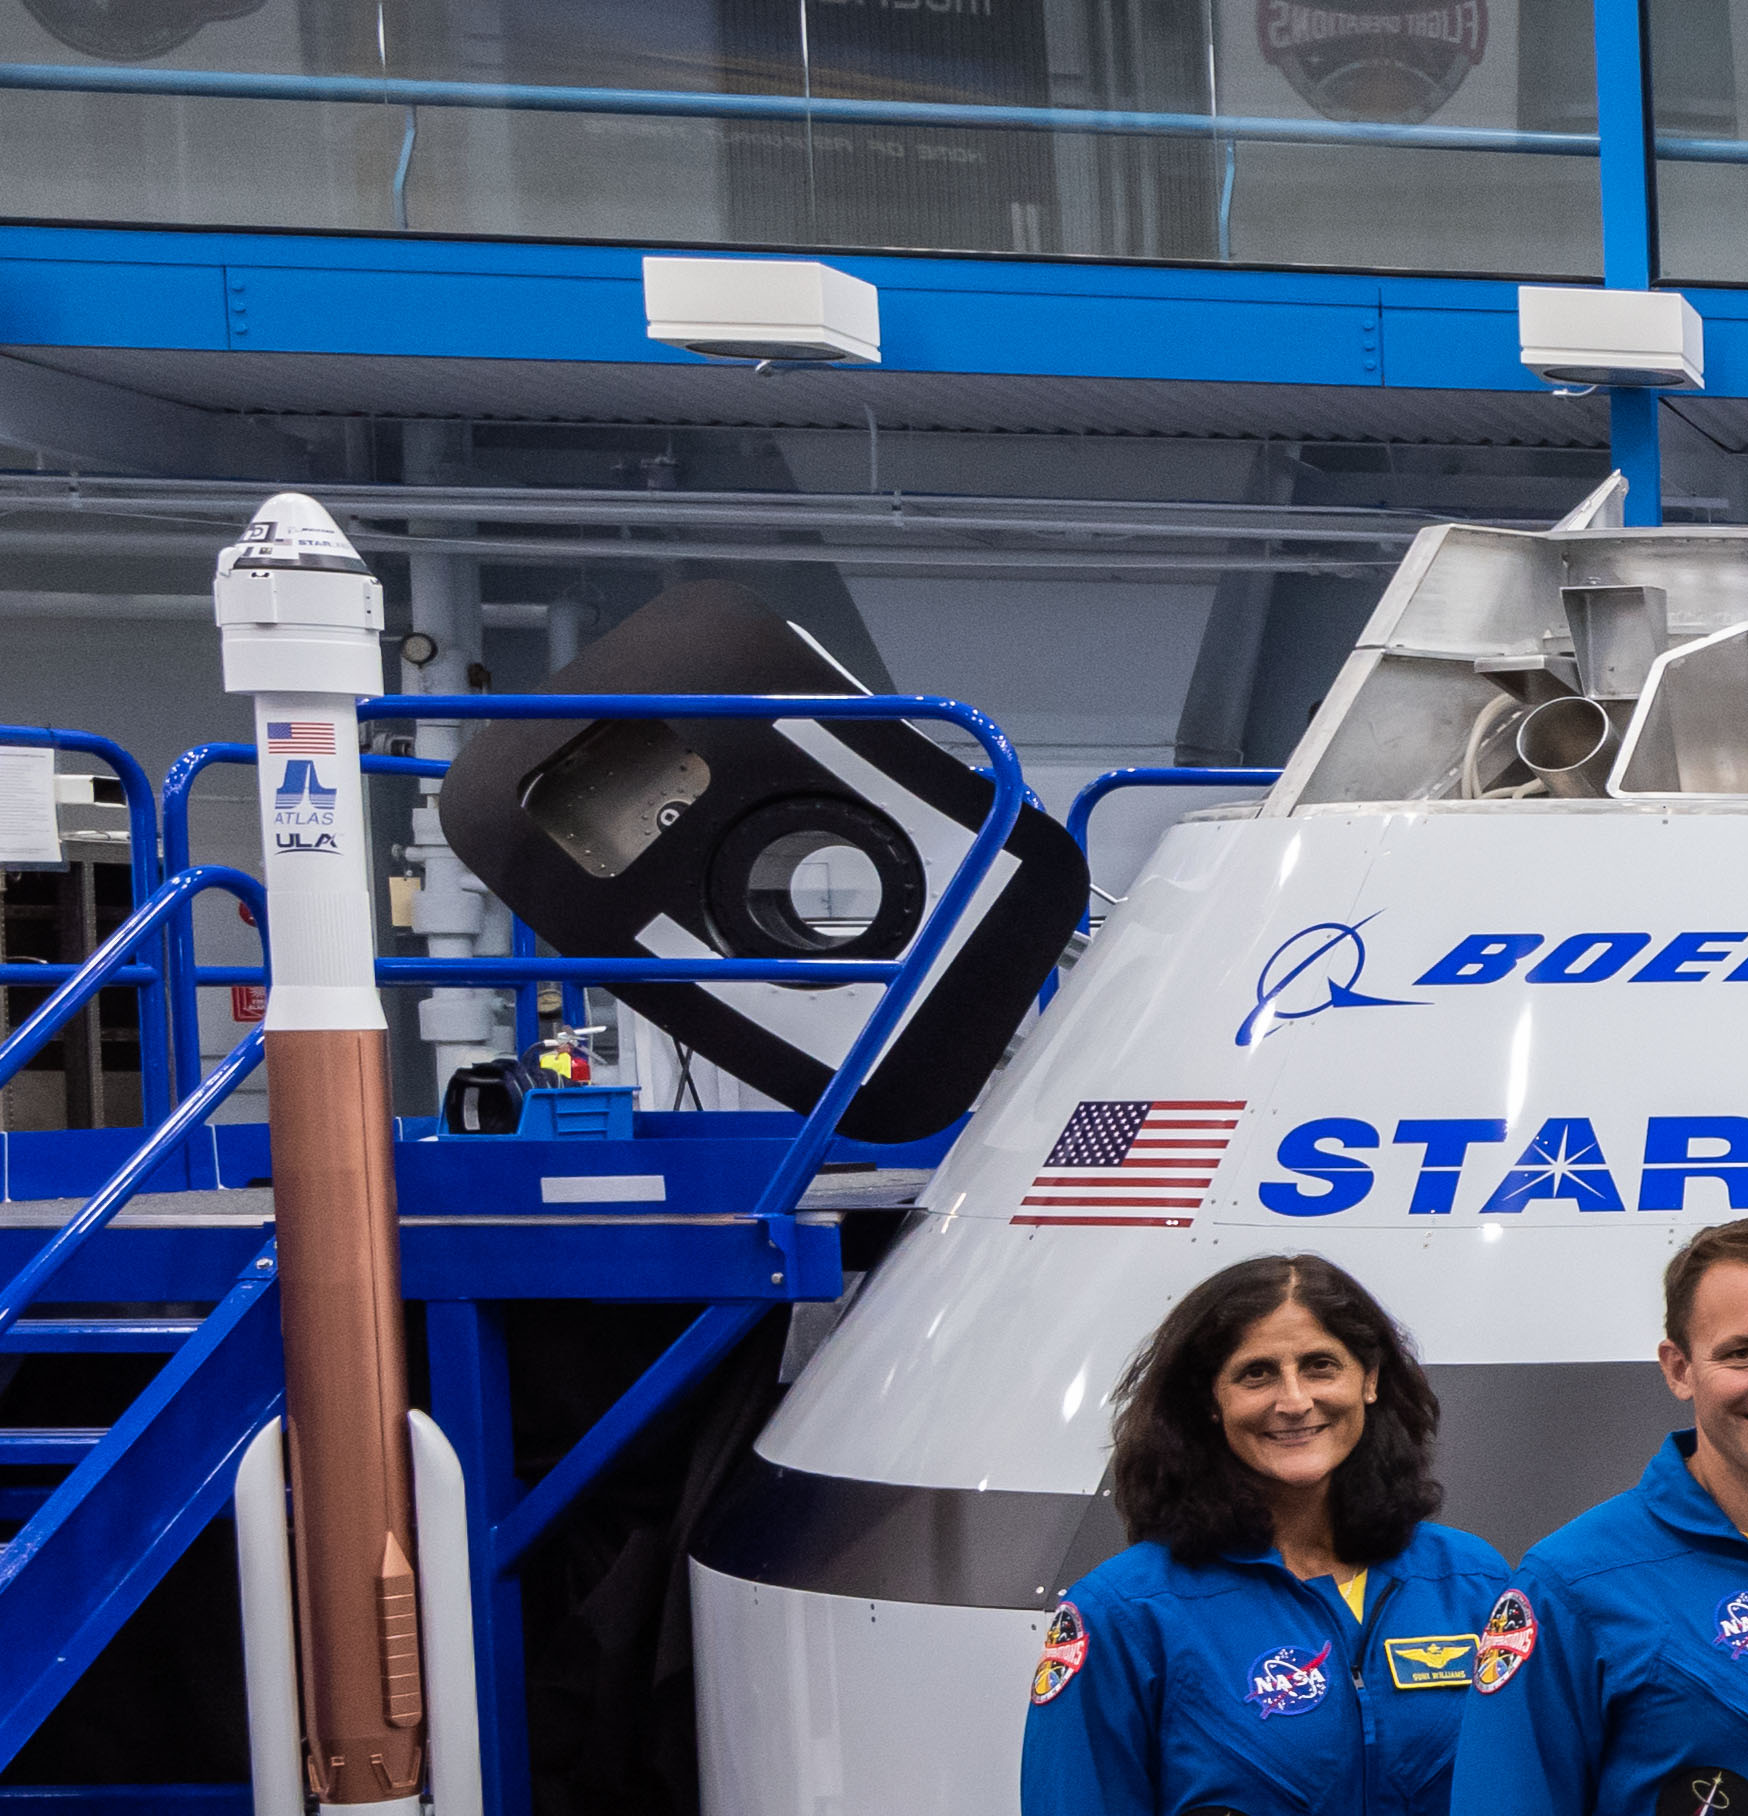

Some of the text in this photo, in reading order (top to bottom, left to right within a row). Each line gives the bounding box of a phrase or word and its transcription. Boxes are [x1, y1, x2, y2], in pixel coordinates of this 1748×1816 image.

[274, 812, 334, 826] ATLAS
[276, 832, 338, 849] ULA
[1253, 1667, 1327, 1695] NASA
[1432, 1670, 1467, 1680] WILLIAMS
